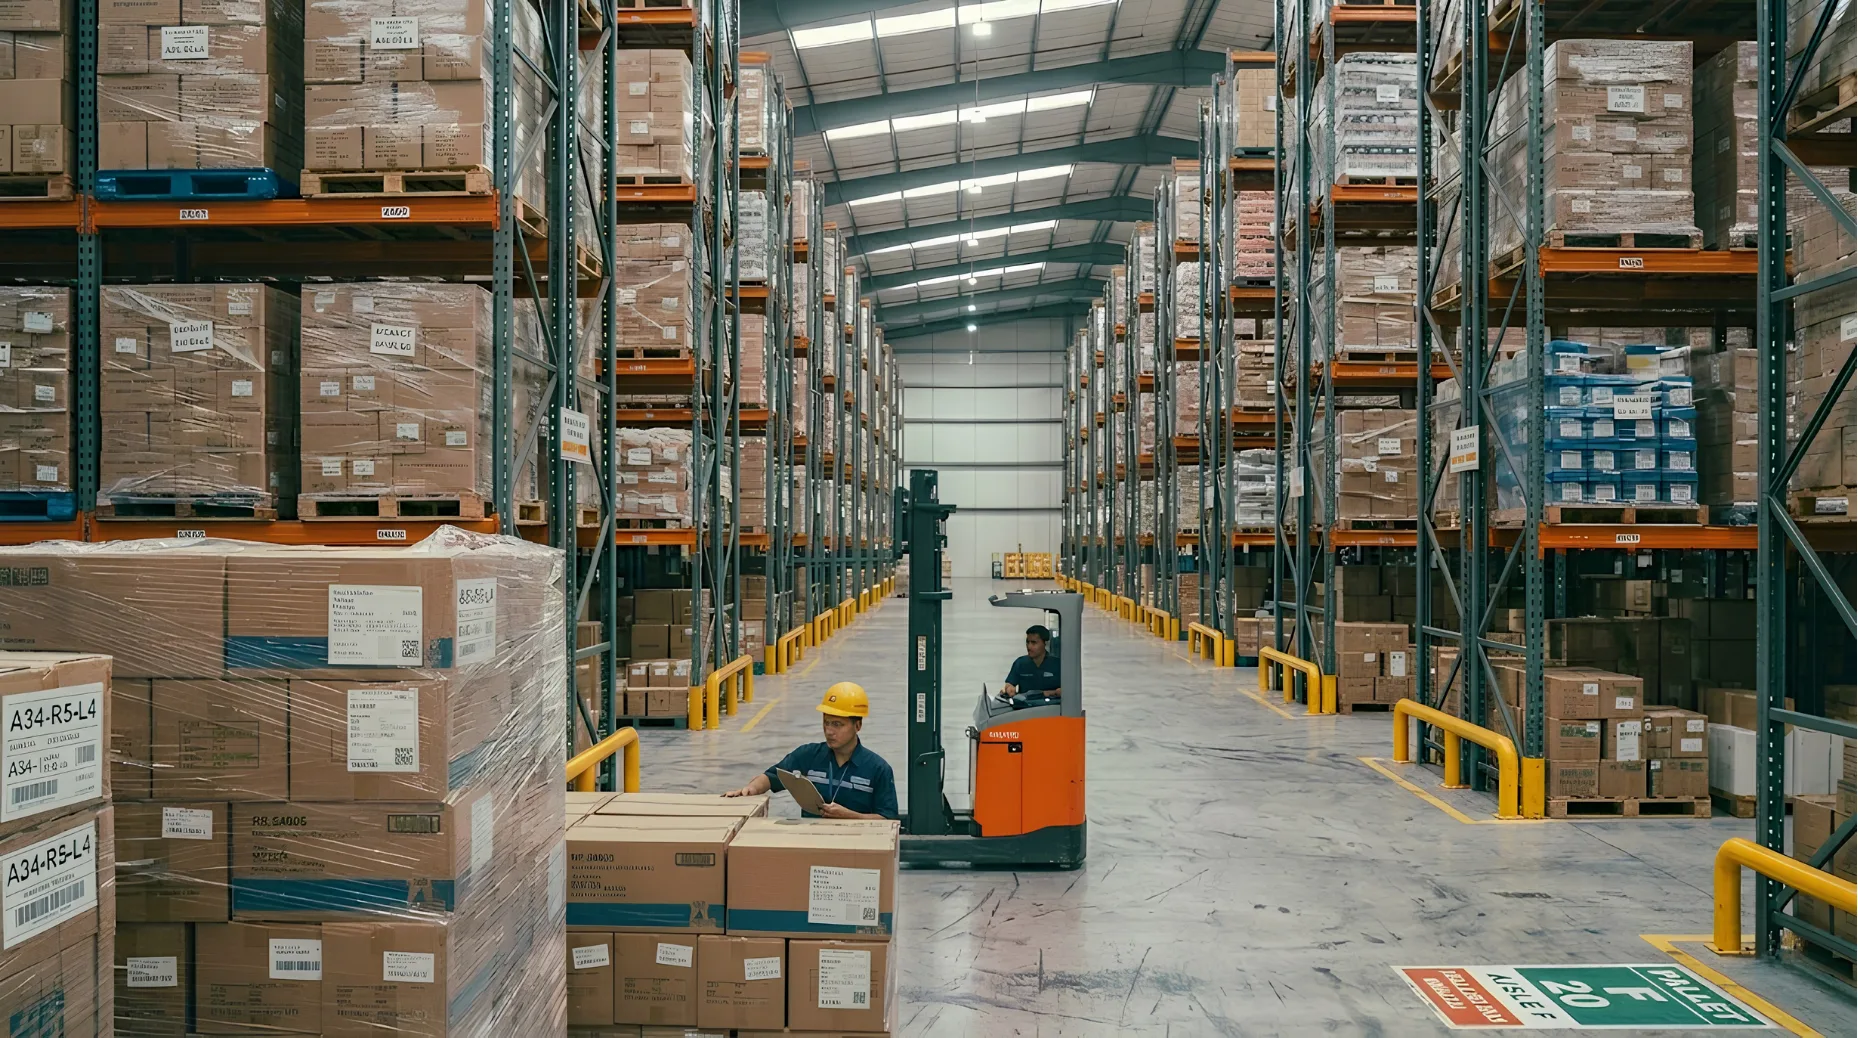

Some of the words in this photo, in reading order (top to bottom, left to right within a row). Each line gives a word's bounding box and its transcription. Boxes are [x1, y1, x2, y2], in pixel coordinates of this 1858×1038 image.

[10, 698, 97, 732] A34-R5-L4
[1486, 973, 1546, 1009] AISLE
[1538, 980, 1611, 1008] 20
[1602, 987, 1669, 1002] F
[1647, 970, 1750, 1022] PALLET
